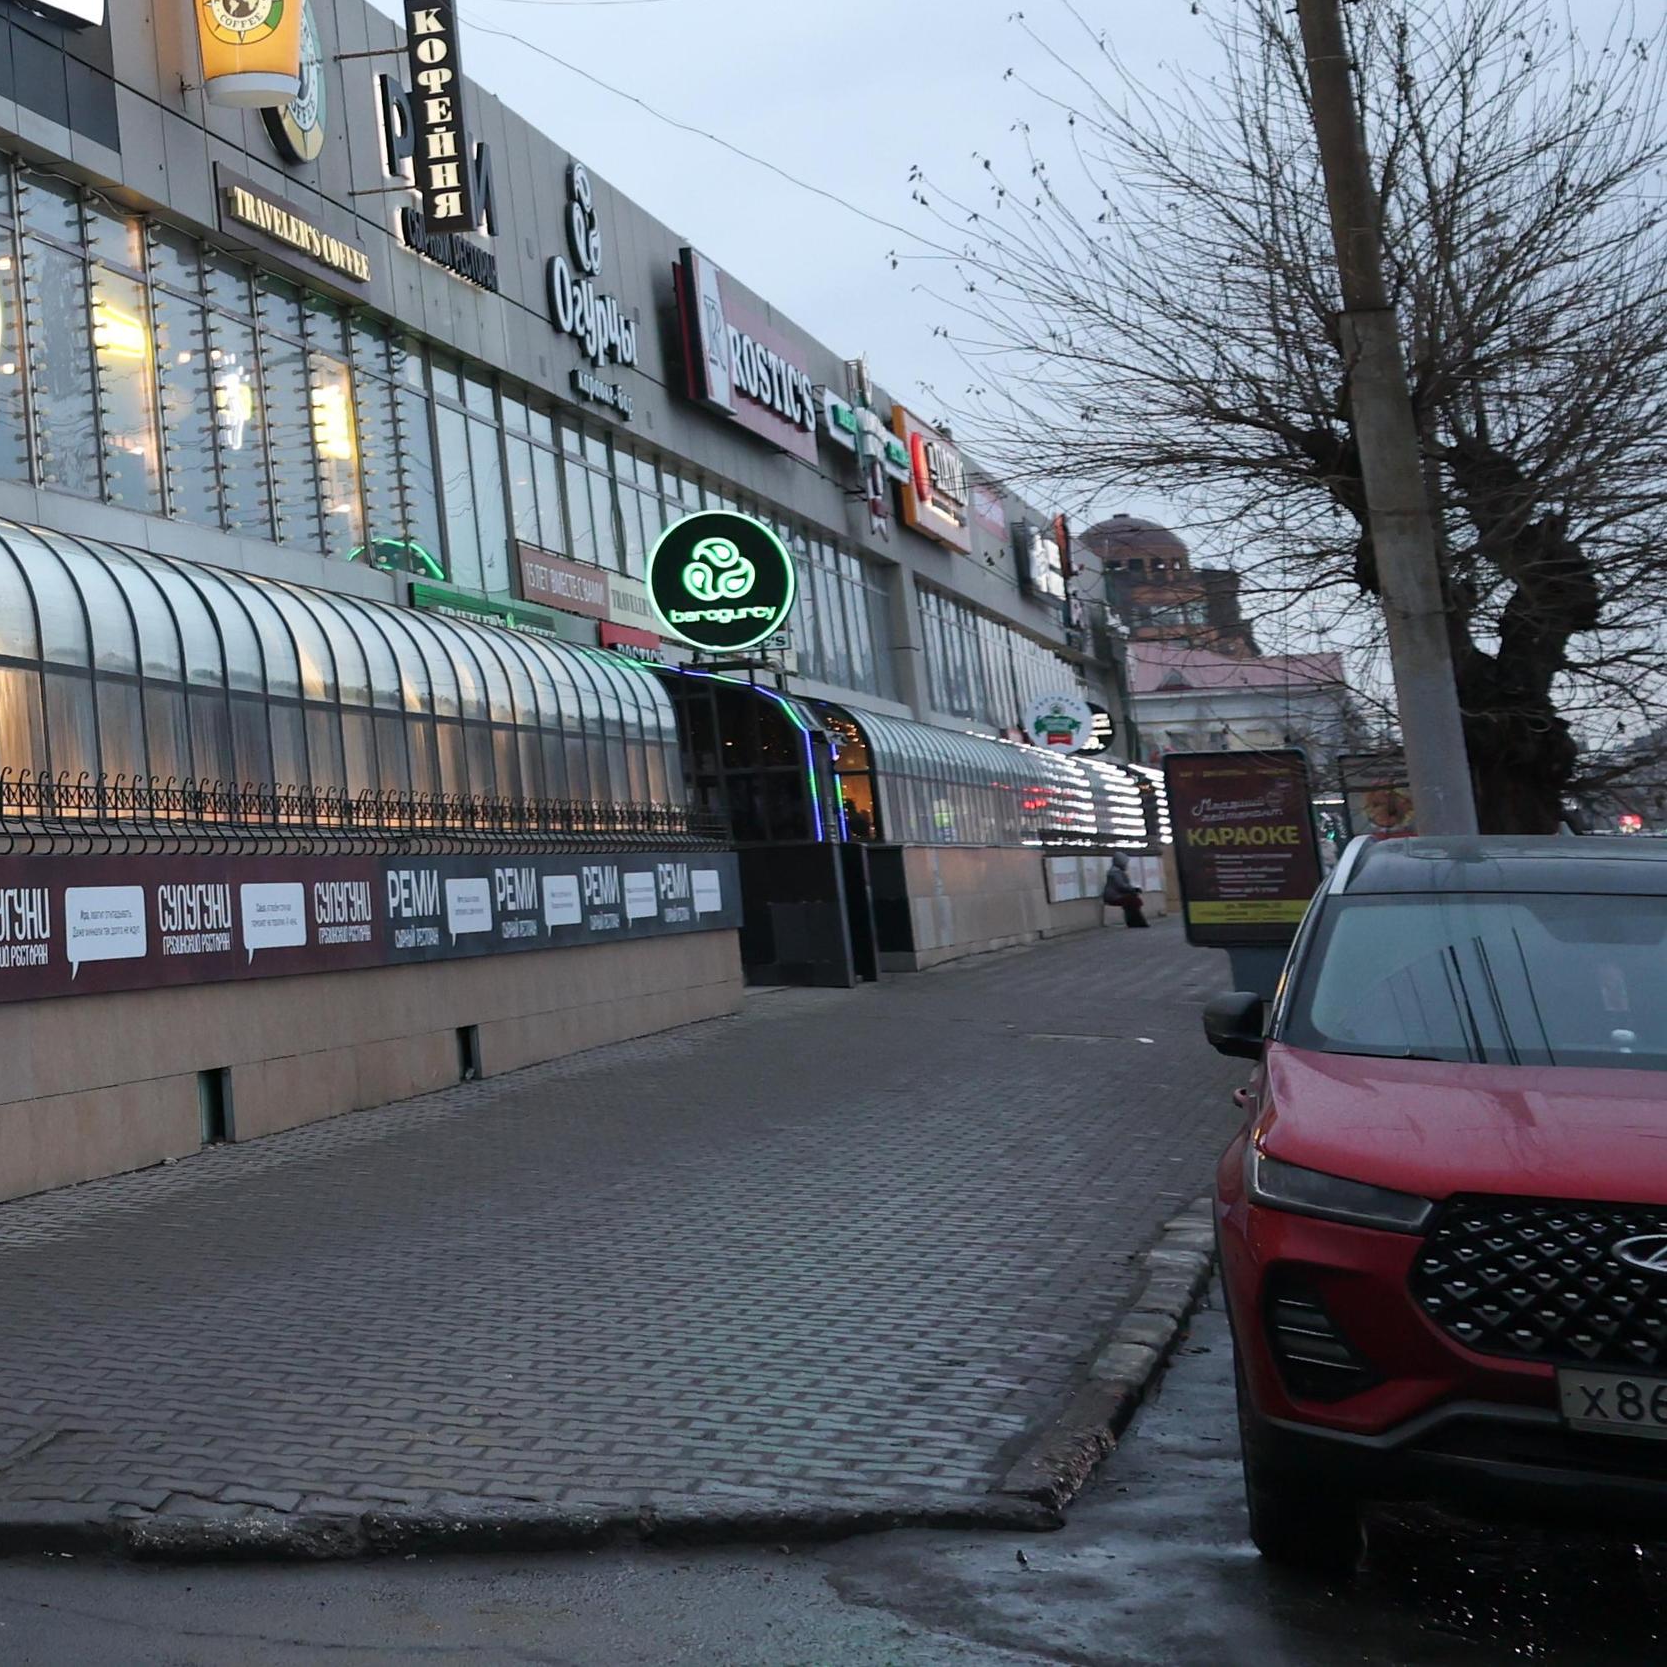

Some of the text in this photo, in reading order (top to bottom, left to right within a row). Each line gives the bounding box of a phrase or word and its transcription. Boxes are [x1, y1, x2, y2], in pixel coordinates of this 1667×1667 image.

[219, 13, 263, 29] COFFEE
[411, 6, 465, 219] КОФЕЙНЯ
[232, 185, 371, 283] TRAVELER'S COFFEE
[550, 255, 638, 368] Огурцы
[727, 323, 816, 432] ROSTIC'S
[669, 606, 777, 624] barogurcy
[1187, 825, 1301, 847] КАРАОКЕ
[314, 881, 372, 924] СУЛУГУНИ
[387, 869, 441, 919] РЕМИ
[495, 867, 539, 912] РЕМИ
[582, 865, 621, 906] РЕМИ
[657, 862, 690, 900] РЕМИ
[157, 883, 232, 932] СУЛУГУНИ
[11, 943, 49, 968] РЕСТОРАН
